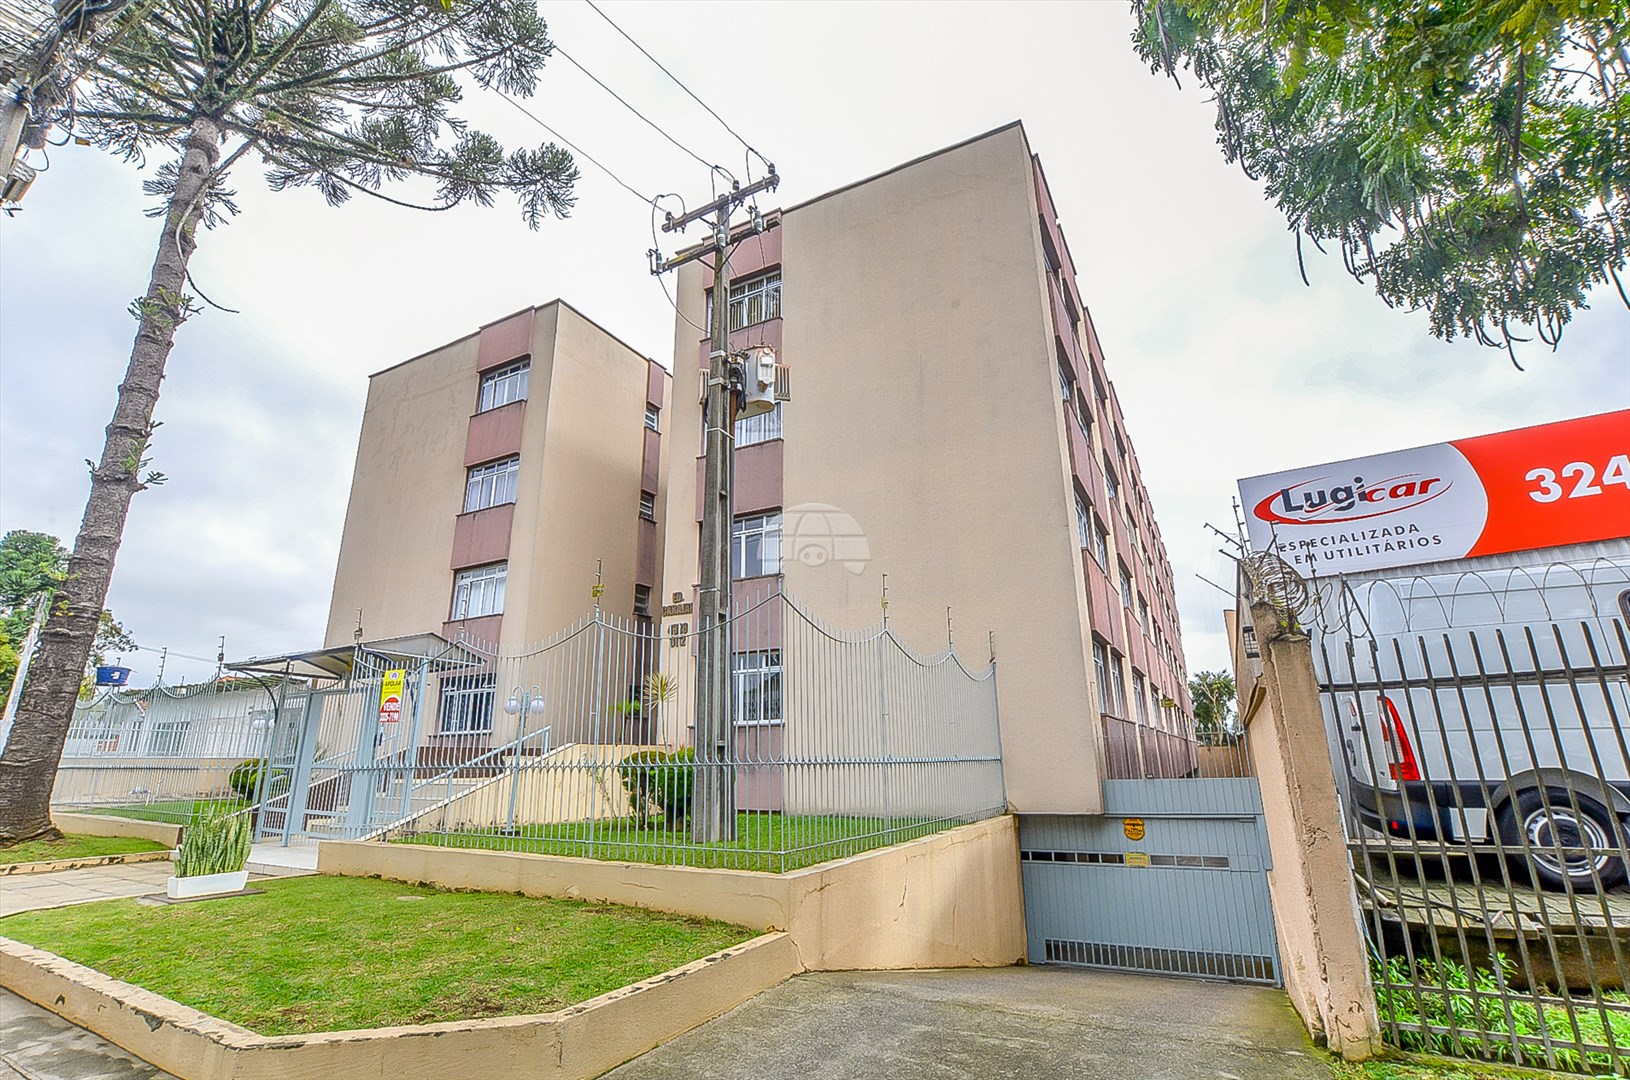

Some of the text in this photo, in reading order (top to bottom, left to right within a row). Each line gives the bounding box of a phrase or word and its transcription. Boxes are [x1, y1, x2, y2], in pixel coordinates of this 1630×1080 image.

[1281, 476, 1441, 513] Lugicar
[1279, 523, 1420, 552] ESPECIALIZADA
[1294, 534, 1442, 565] EM UTILITÁRIOS
